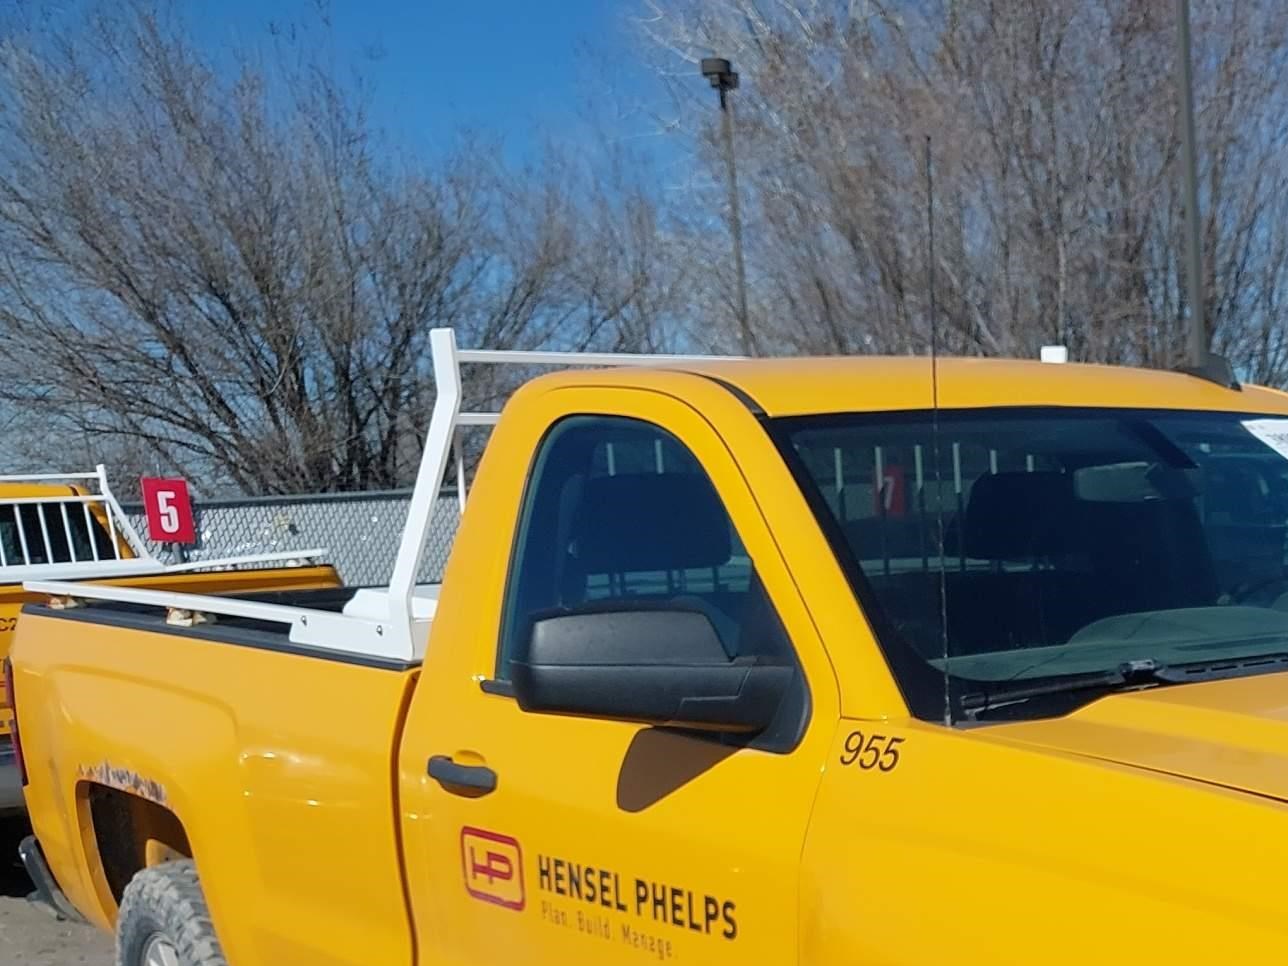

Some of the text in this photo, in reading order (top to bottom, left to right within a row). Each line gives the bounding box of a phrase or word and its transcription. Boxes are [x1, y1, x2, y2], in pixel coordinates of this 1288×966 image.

[156, 490, 180, 534] 5
[840, 730, 905, 772] 955
[538, 854, 738, 940] HENSEL PHELPS
